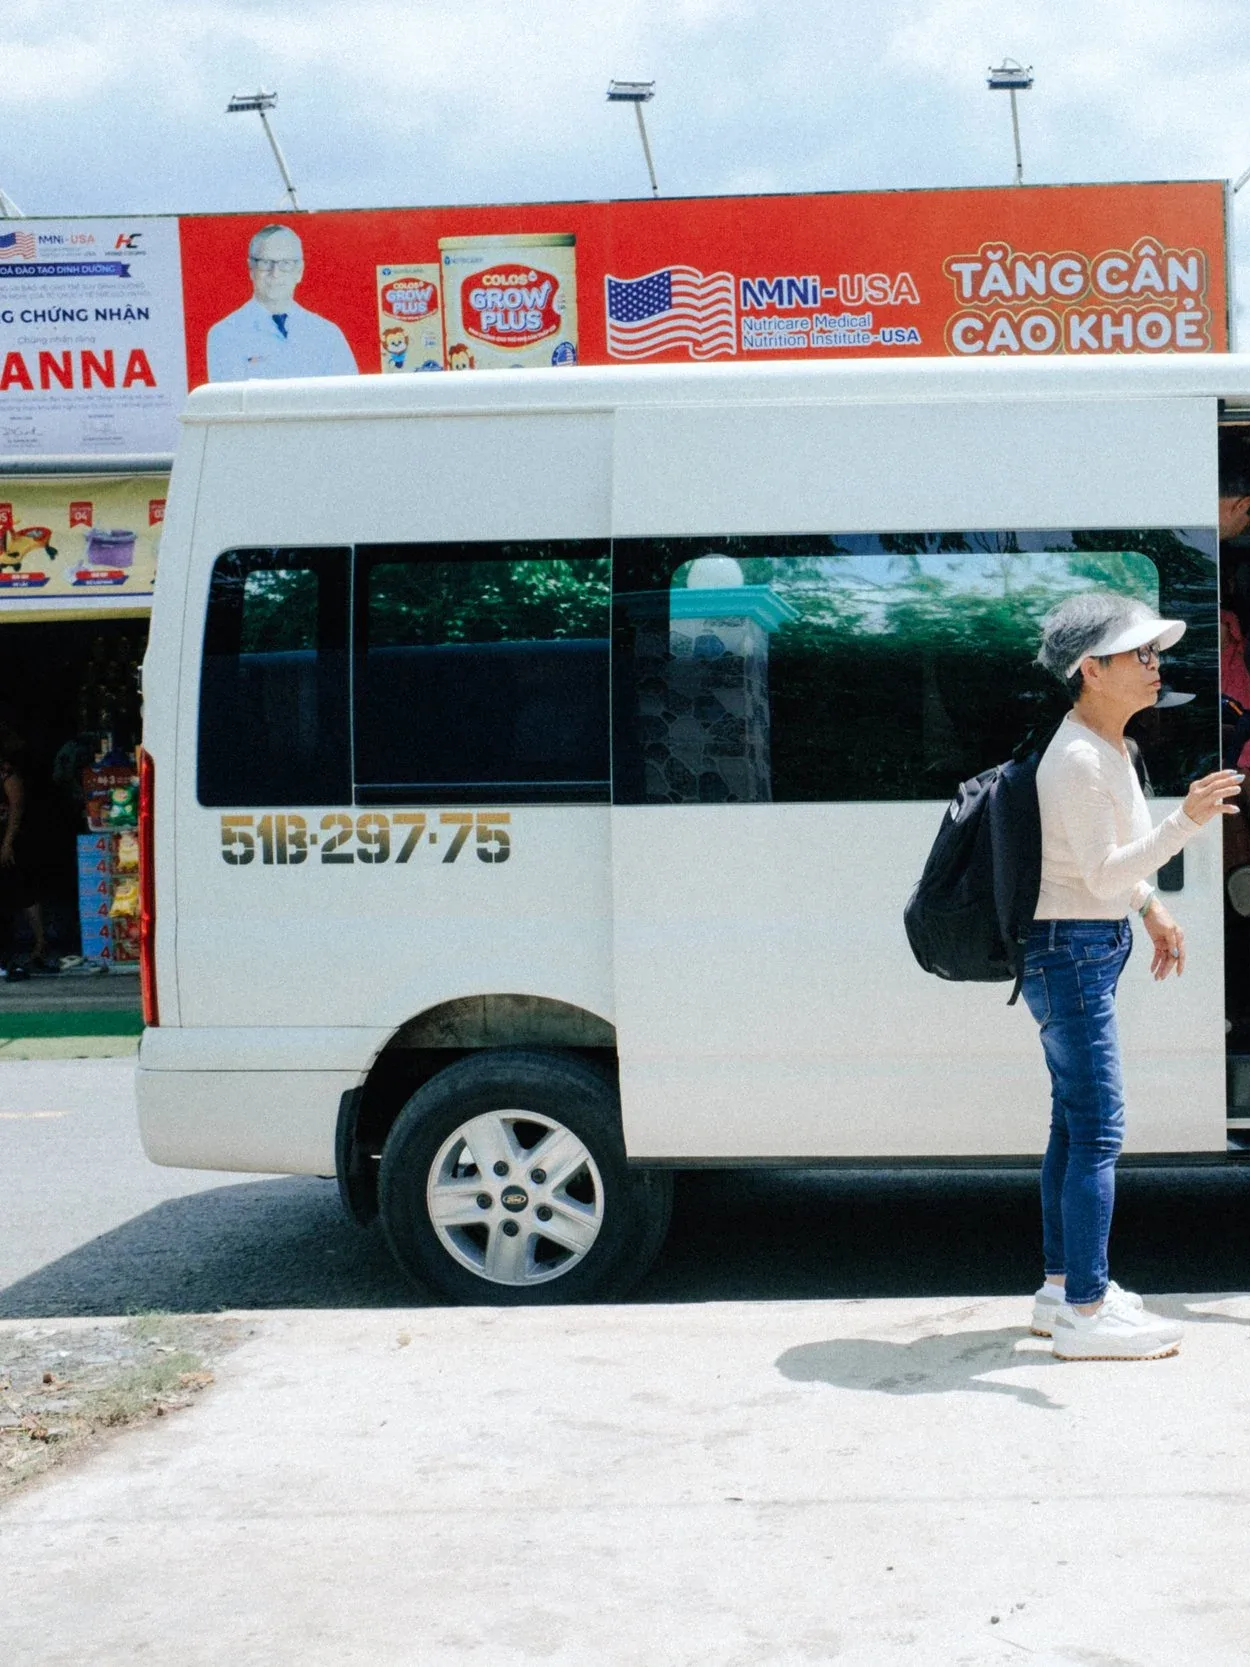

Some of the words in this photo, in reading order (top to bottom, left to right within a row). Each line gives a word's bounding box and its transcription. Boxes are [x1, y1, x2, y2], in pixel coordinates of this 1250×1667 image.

[482, 274, 528, 286] COLOS
[951, 250, 1084, 298] TĂNG
[1096, 245, 1198, 294] CÂN
[386, 285, 433, 303] GROW
[469, 280, 552, 311] GROW
[20, 304, 89, 324] CHỨNG
[95, 304, 150, 325] NHẬN
[393, 302, 428, 315] PLUS
[481, 310, 543, 333] PLUS
[742, 316, 810, 332] Nutricare
[813, 312, 872, 329] Medical
[742, 333, 807, 349] Nutrition
[952, 315, 1056, 353] CAO
[0, 348, 157, 391] ANNA
[75, 512, 87, 520] 04
